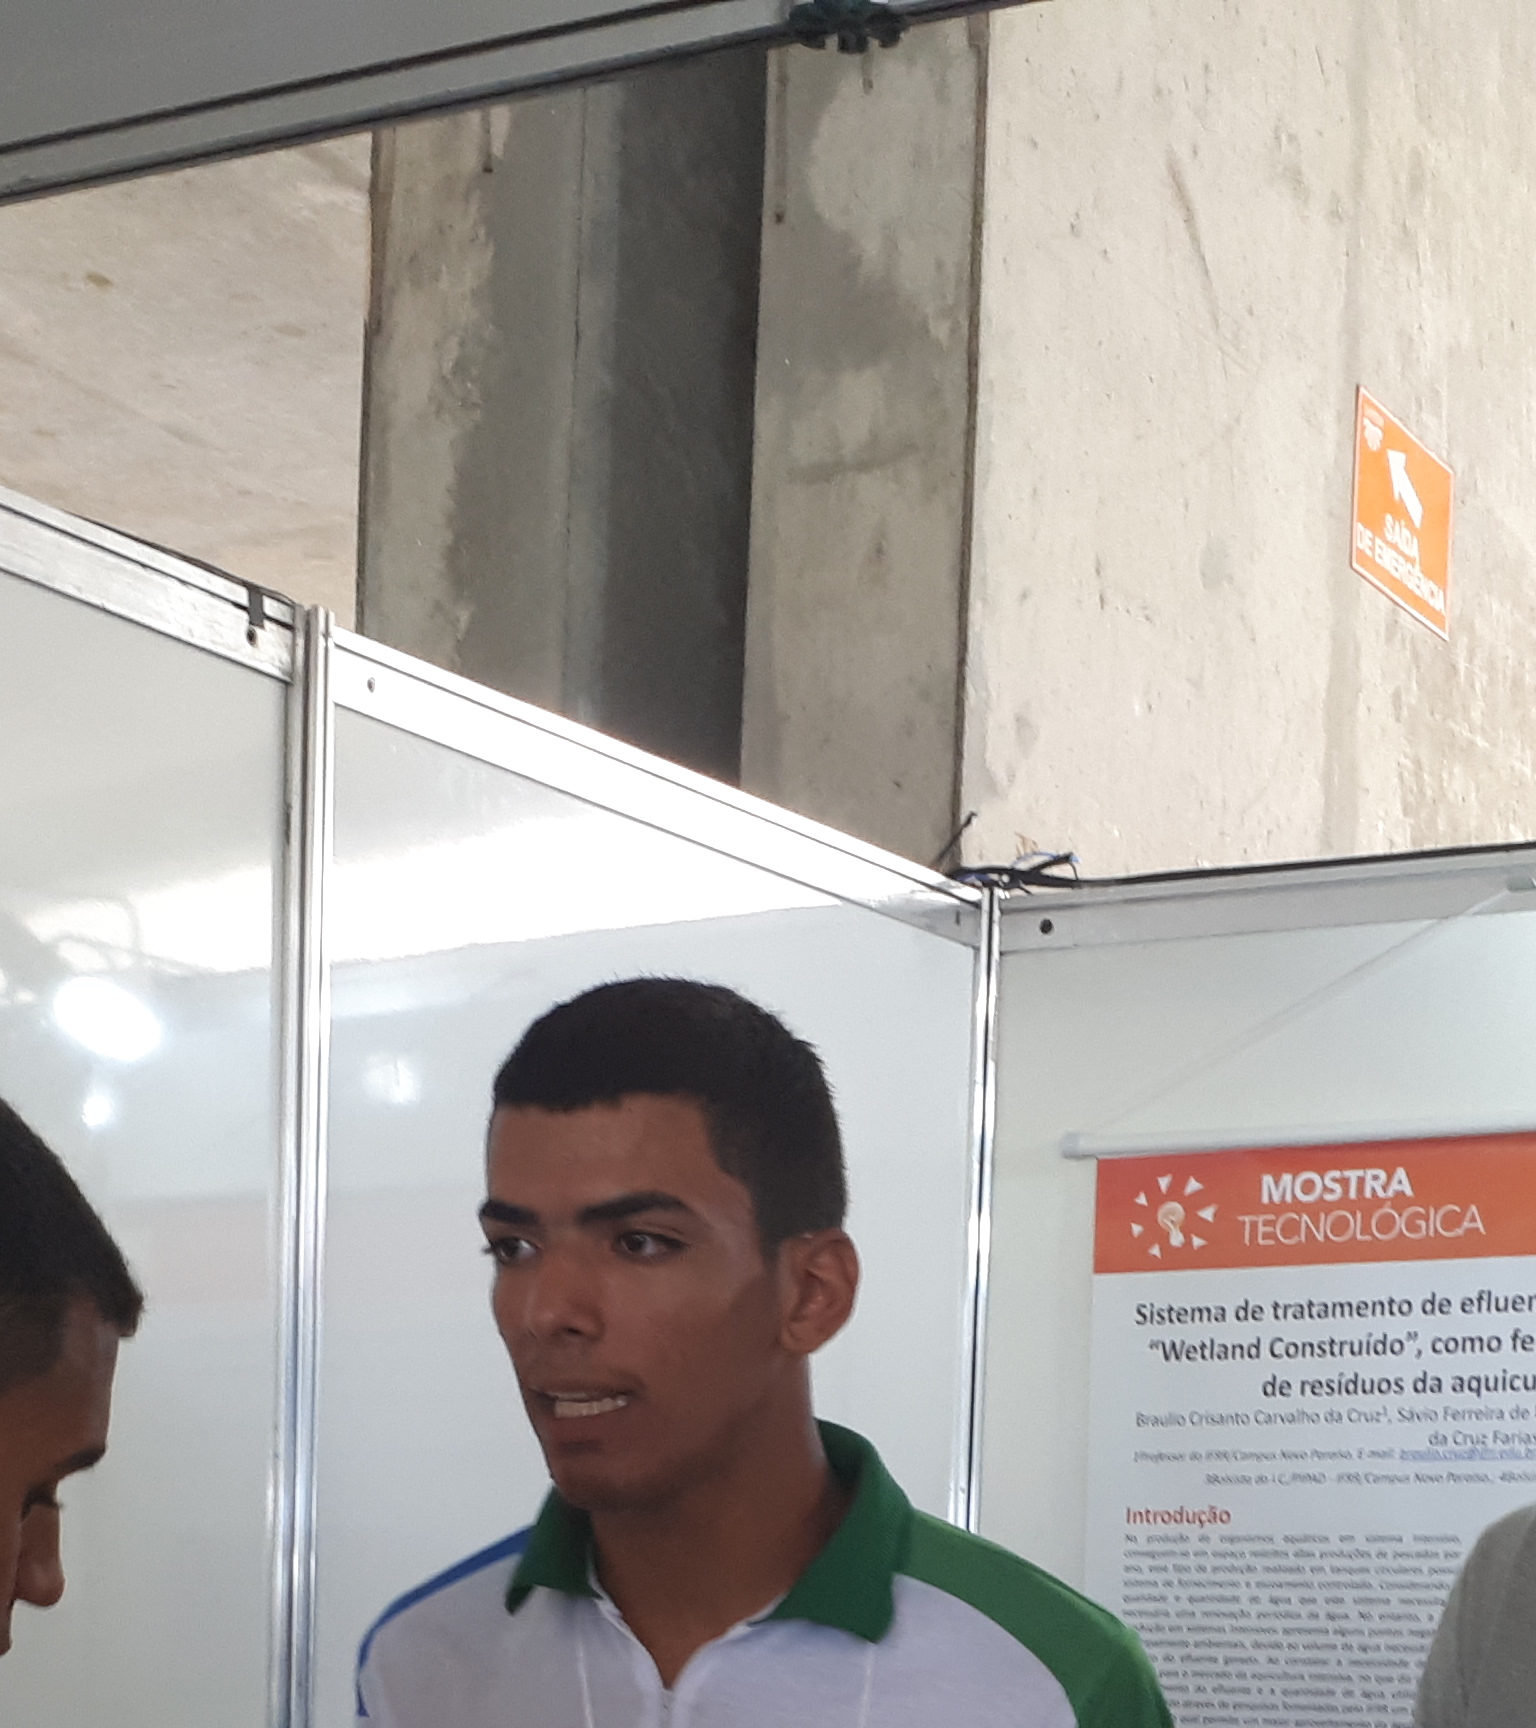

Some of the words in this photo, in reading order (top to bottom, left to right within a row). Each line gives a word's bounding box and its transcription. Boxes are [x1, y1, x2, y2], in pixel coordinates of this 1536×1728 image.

[1357, 522, 1375, 558] DE
[1261, 1167, 1413, 1204] MOSTRA
[1238, 1201, 1486, 1246] TECNOLÓGICA
[1135, 1299, 1226, 1326] Sistema
[1235, 1298, 1264, 1323] de
[1271, 1293, 1413, 1322] tratamento
[1421, 1292, 1452, 1317] de
[1431, 1336, 1501, 1355] como
[1262, 1374, 1291, 1398] de
[1300, 1372, 1404, 1397] resíduos
[1414, 1371, 1442, 1395] da
[1126, 1506, 1231, 1528] Introdução
